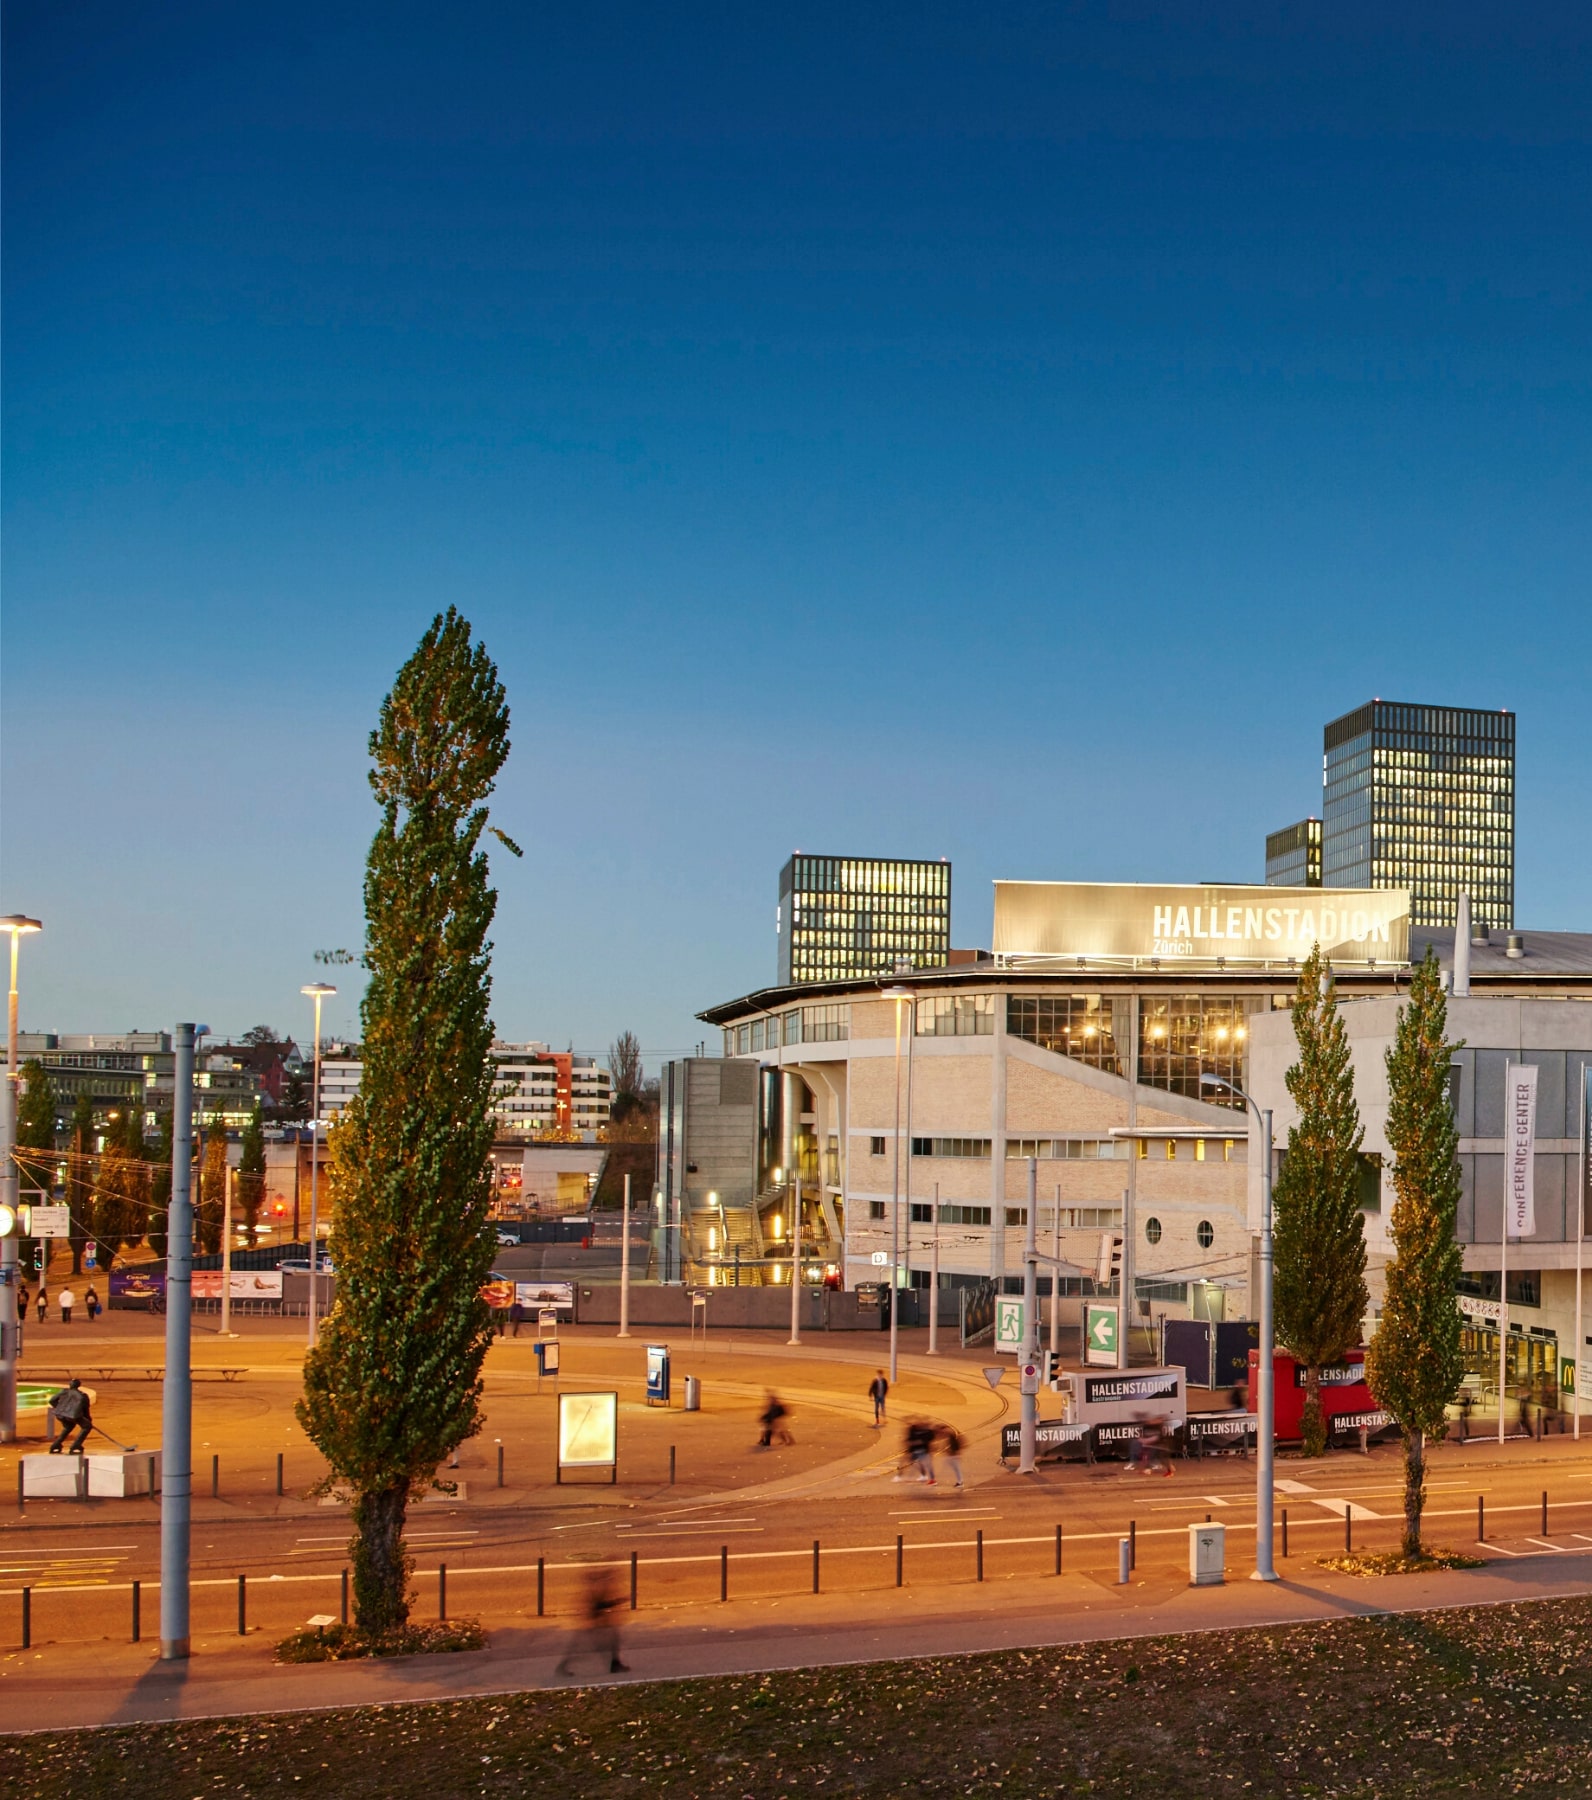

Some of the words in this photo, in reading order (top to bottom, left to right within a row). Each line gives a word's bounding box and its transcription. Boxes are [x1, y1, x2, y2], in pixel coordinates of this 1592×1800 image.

[1153, 905, 1390, 943] HALLENSTADION
[1152, 939, 1193, 955] Zürich
[1516, 1084, 1530, 1134] CENTER
[1300, 1368, 1365, 1381] HLENSTADI
[1091, 1381, 1172, 1397] HALLENSTADION
[1190, 1421, 1258, 1436] HLLENSTADIO
[1335, 1412, 1400, 1429] HALLENSTA
[1006, 1430, 1083, 1442] HANSTADION
[1098, 1426, 1175, 1440] HALLENSON
